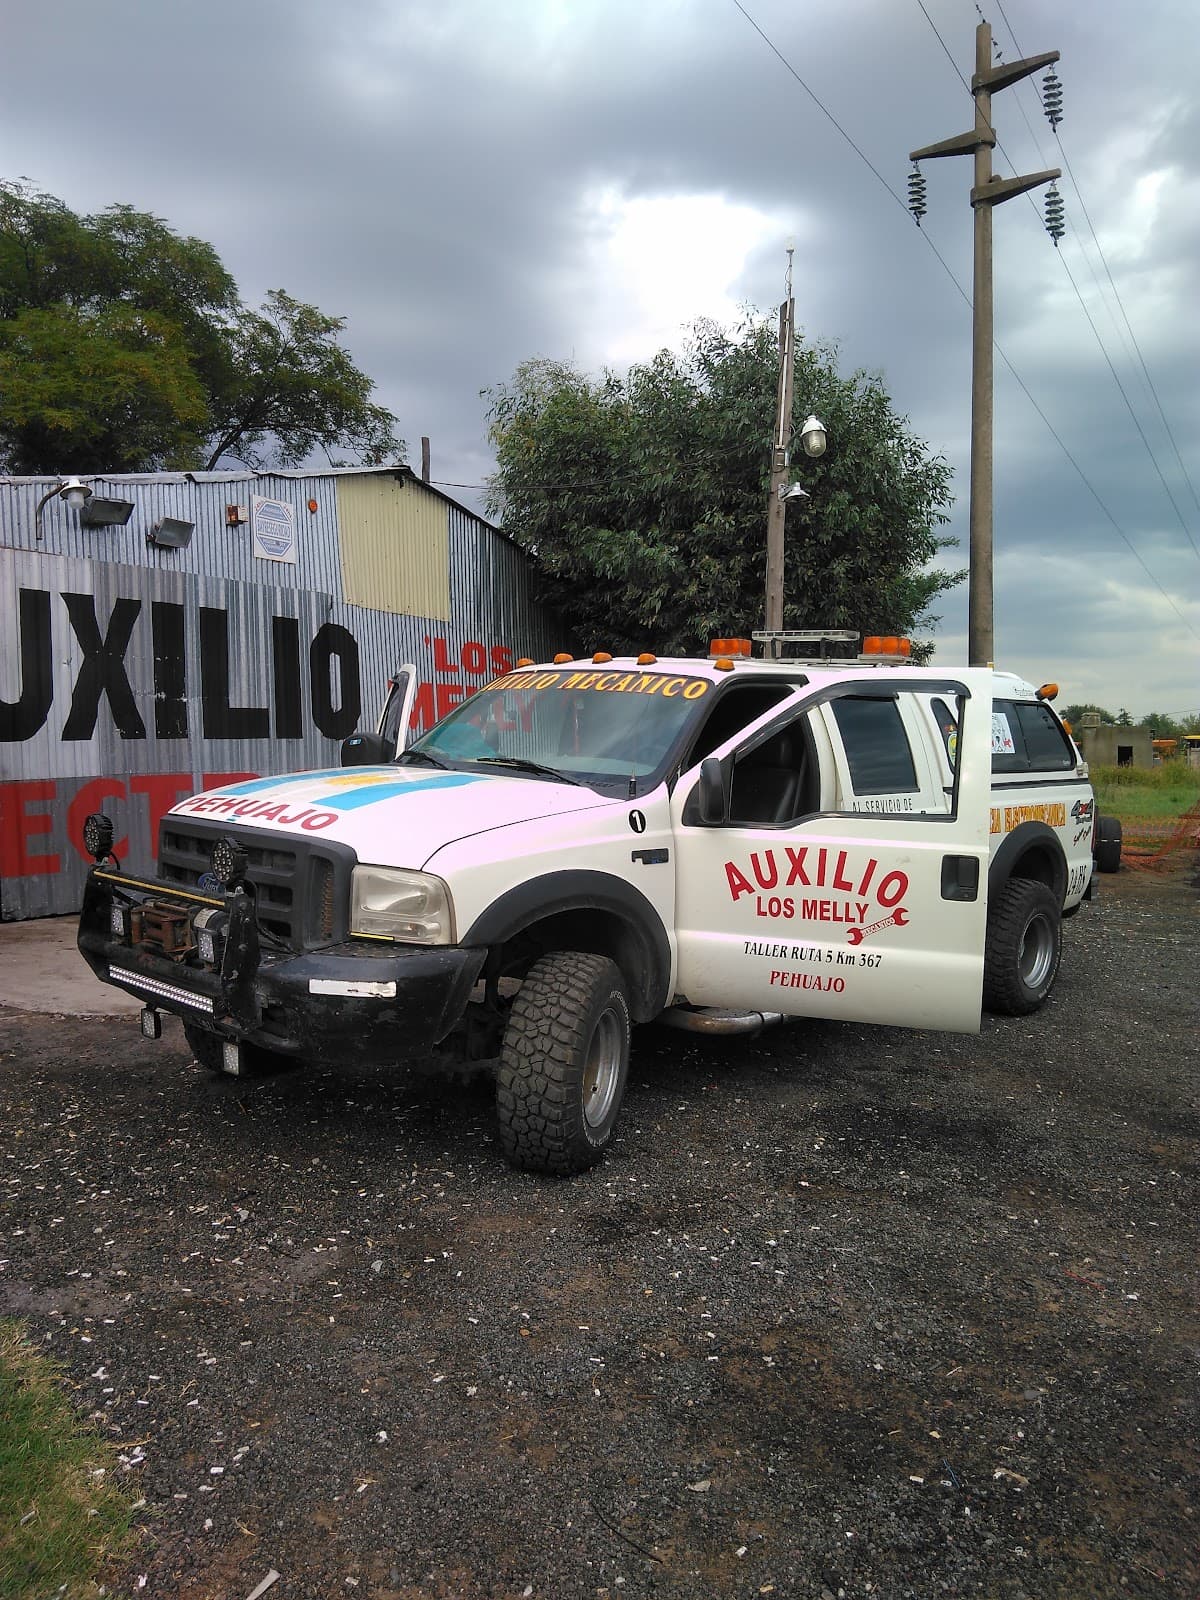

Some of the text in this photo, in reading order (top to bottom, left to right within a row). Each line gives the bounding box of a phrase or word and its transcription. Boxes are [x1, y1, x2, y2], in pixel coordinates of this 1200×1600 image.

[557, 671, 709, 700] MECANICO
[173, 797, 339, 831] PEHUAJO
[865, 798, 901, 814] SERVICIO
[903, 797, 913, 811] DE
[724, 847, 909, 908] AUXILIO
[756, 896, 869, 924] LOS MELLY
[744, 941, 882, 968] TALLER RUTA 5 Km 367
[769, 970, 846, 993] PEHUAJO
